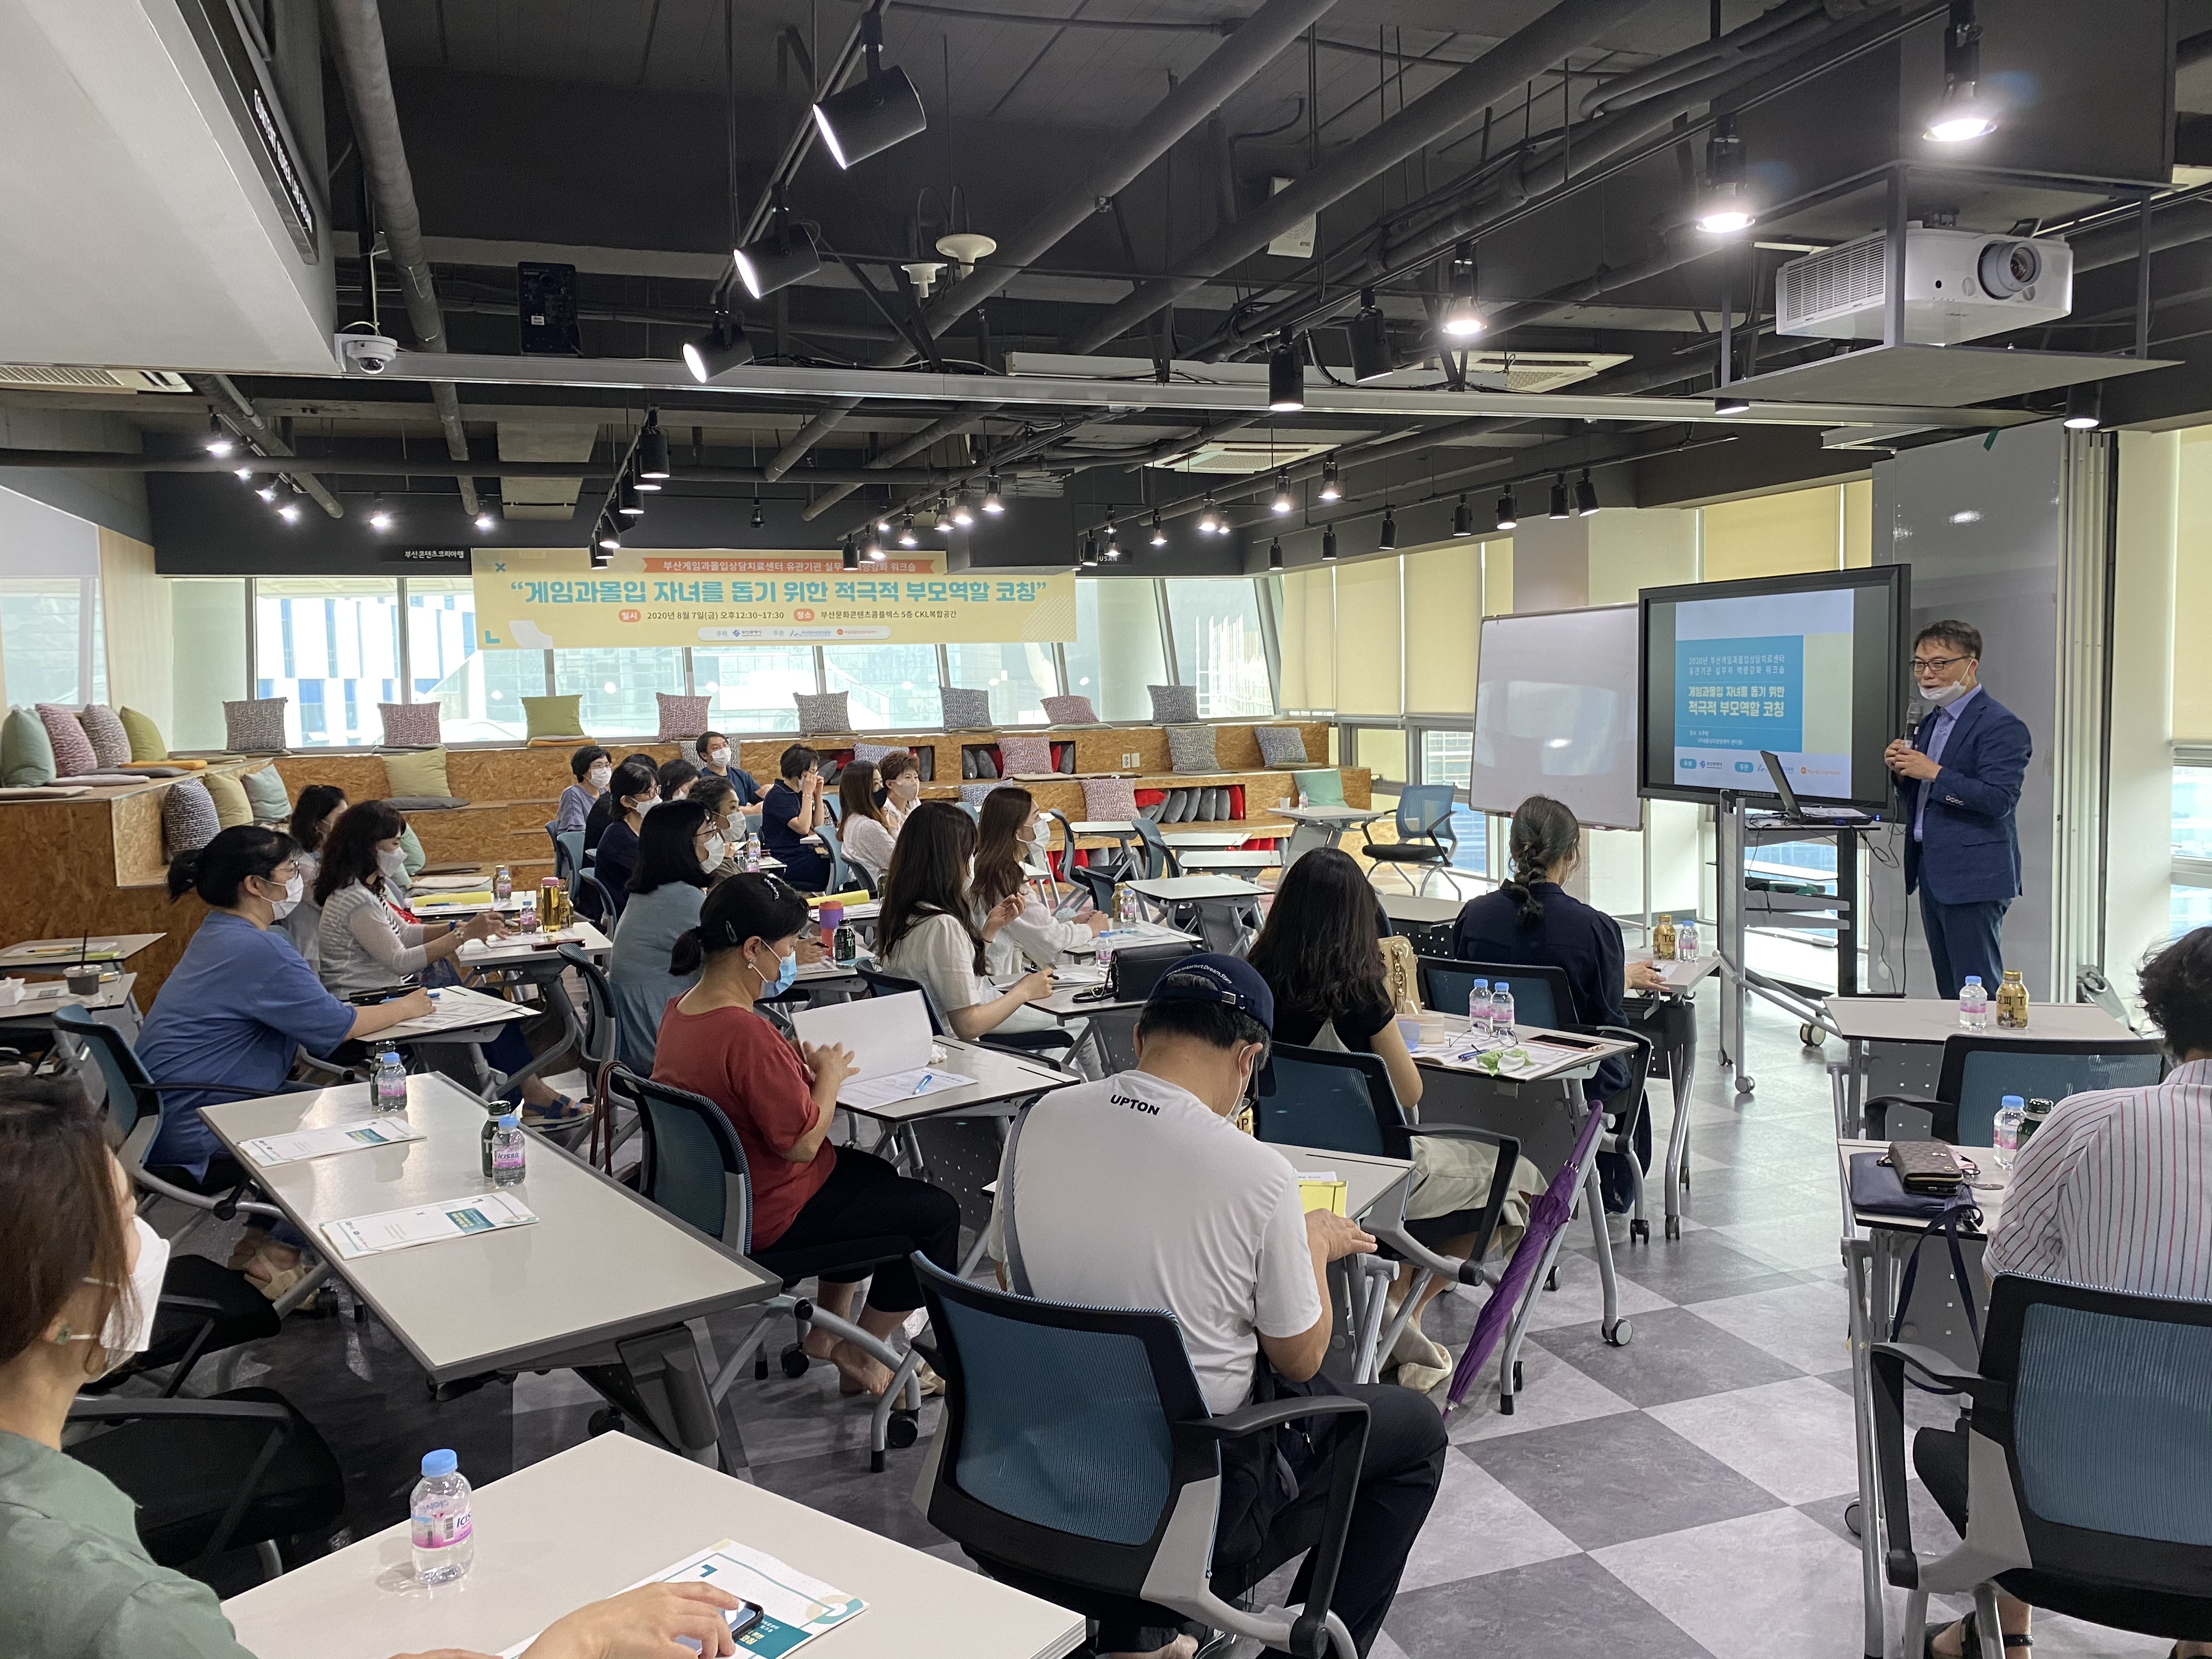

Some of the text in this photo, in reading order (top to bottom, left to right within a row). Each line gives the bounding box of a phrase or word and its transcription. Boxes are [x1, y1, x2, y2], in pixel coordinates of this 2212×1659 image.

[404, 550, 464, 558] 부산콘텐츠코리아랩
[663, 561, 783, 571] 부산게임과몰입상담치료센터
[786, 562, 821, 571] 유관기관
[825, 562, 845, 571] 실무
[890, 562, 916, 571] 워크숍
[511, 581, 1046, 603] “게임과몰입 자녀를 돕기 위한 적극적 부모역할 코칭”
[622, 612, 637, 620] 일시
[692, 611, 718, 620] 7일(금)
[820, 611, 900, 619] 부산문화콘텐츠콤플렉스
[1689, 654, 1784, 665] 2020년 부산게임과몰입상담치료센터
[1689, 665, 1784, 675] 유관기관 실무자 역량강화 워크숍
[1689, 686, 1784, 697] 게임과몰입 자녀를 돕기 위한
[1689, 701, 1784, 717] 적극적 부모역할 코칭
[1110, 1094, 1160, 1115] UPTON
